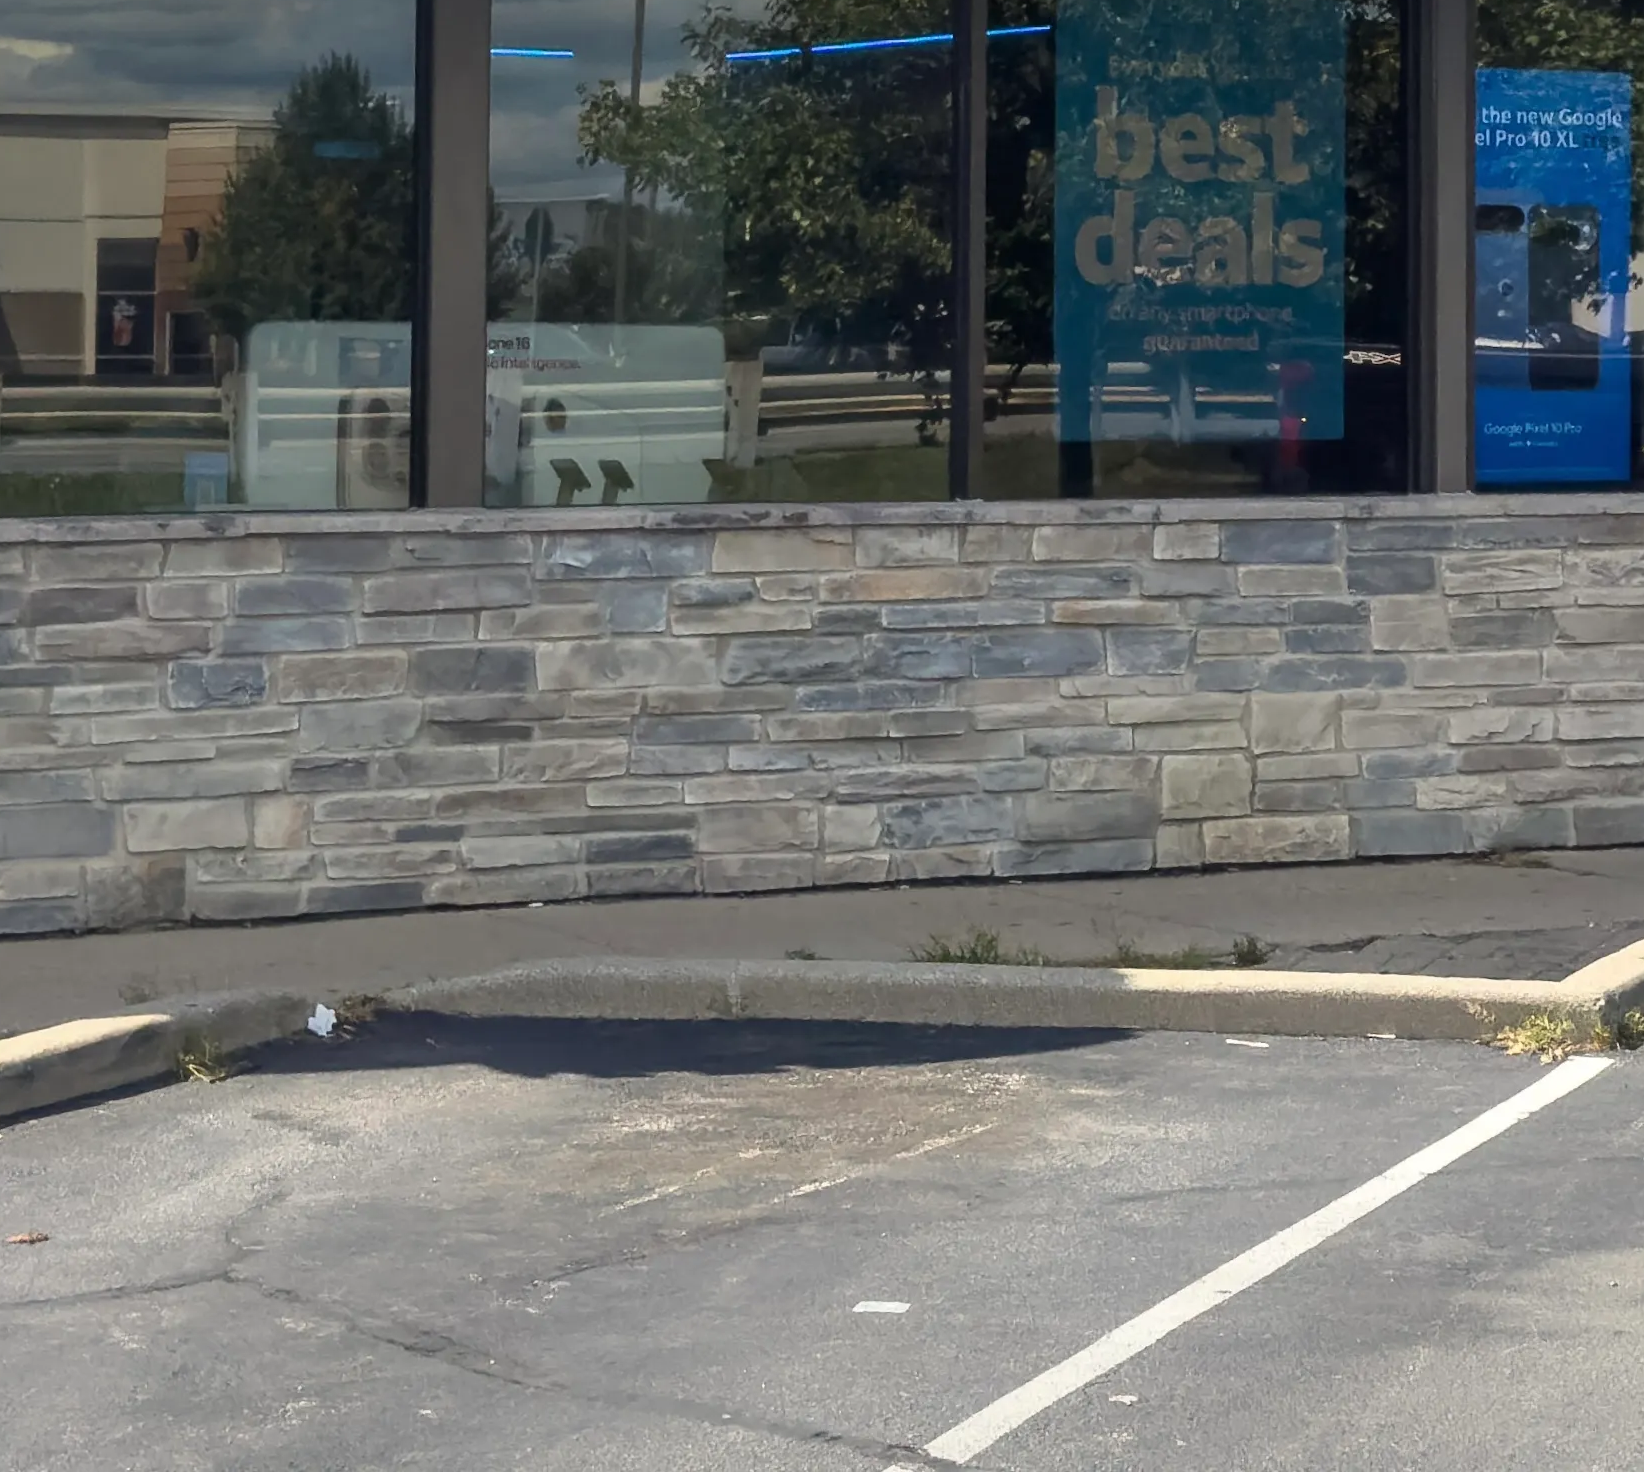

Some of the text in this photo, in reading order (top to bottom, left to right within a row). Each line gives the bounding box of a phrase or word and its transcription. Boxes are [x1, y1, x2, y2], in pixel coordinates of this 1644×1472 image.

[1482, 106, 1623, 131] the new Google
[1094, 85, 1311, 185] best
[1496, 130, 1527, 147] Pro
[1531, 130, 1551, 148] 10
[1556, 131, 1579, 148] XL
[1075, 189, 1325, 287] deals
[488, 340, 514, 350] one
[1484, 423, 1523, 437] Google
[1564, 422, 1583, 434] Pro
